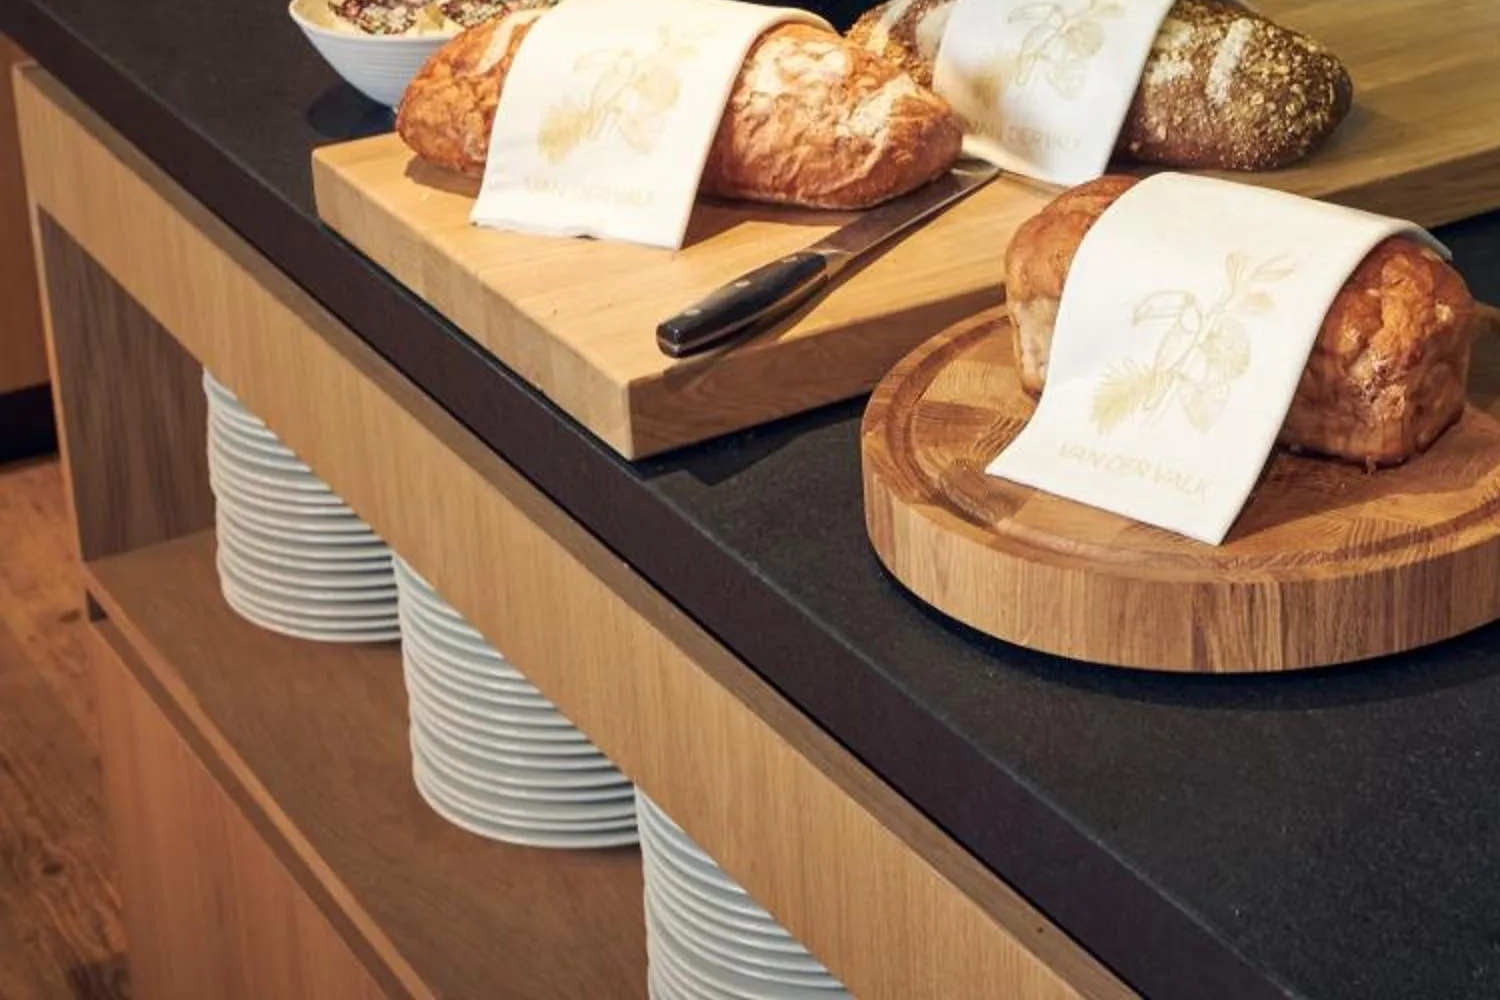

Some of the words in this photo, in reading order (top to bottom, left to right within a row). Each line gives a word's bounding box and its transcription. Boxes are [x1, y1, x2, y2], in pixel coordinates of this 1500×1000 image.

[1058, 442, 1105, 468] VAN
[1105, 453, 1151, 478] DER
[1151, 460, 1214, 500] VALK
